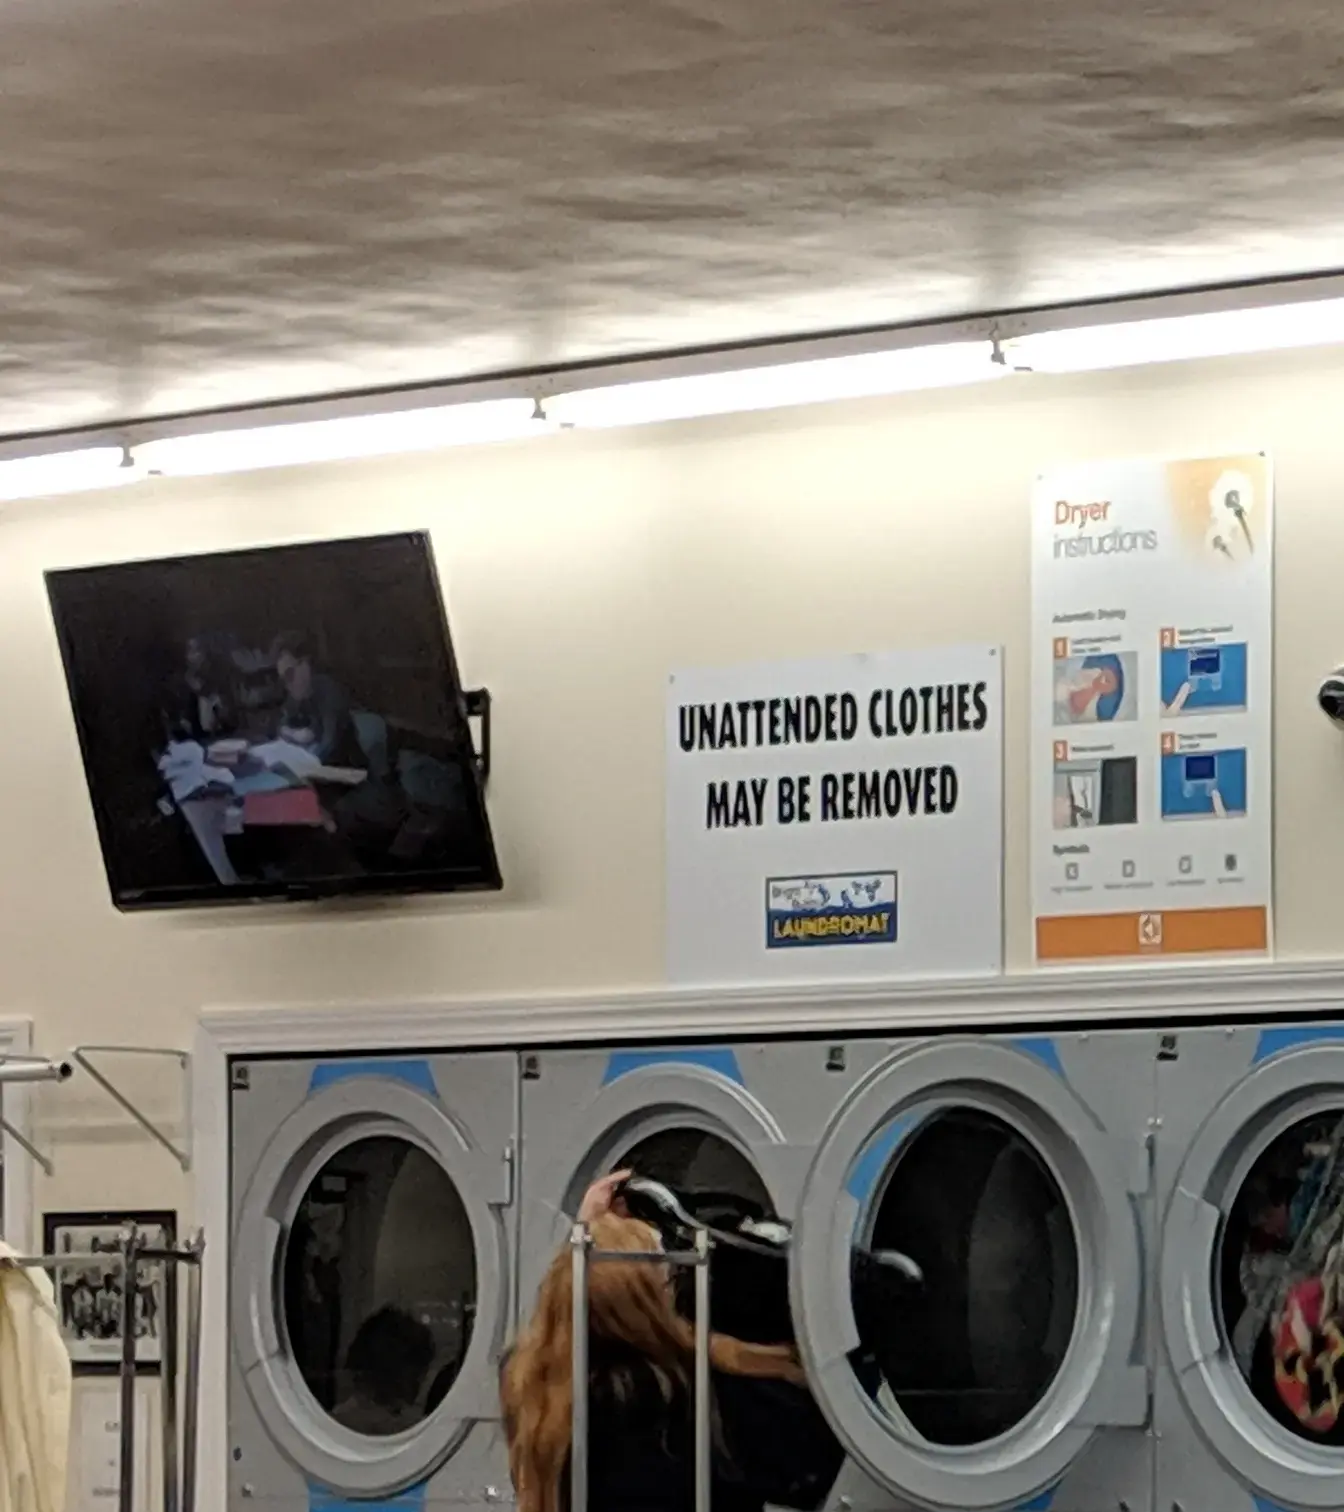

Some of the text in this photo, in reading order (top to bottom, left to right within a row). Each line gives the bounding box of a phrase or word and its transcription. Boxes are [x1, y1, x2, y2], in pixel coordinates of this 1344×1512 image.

[1055, 499, 1111, 529] Dryer
[1053, 527, 1158, 560] instructions
[678, 681, 988, 752] UNATTENDED CLOTHES
[706, 764, 959, 831] MAY BE REMOVED
[773, 911, 891, 939] LAUNDROMAT
